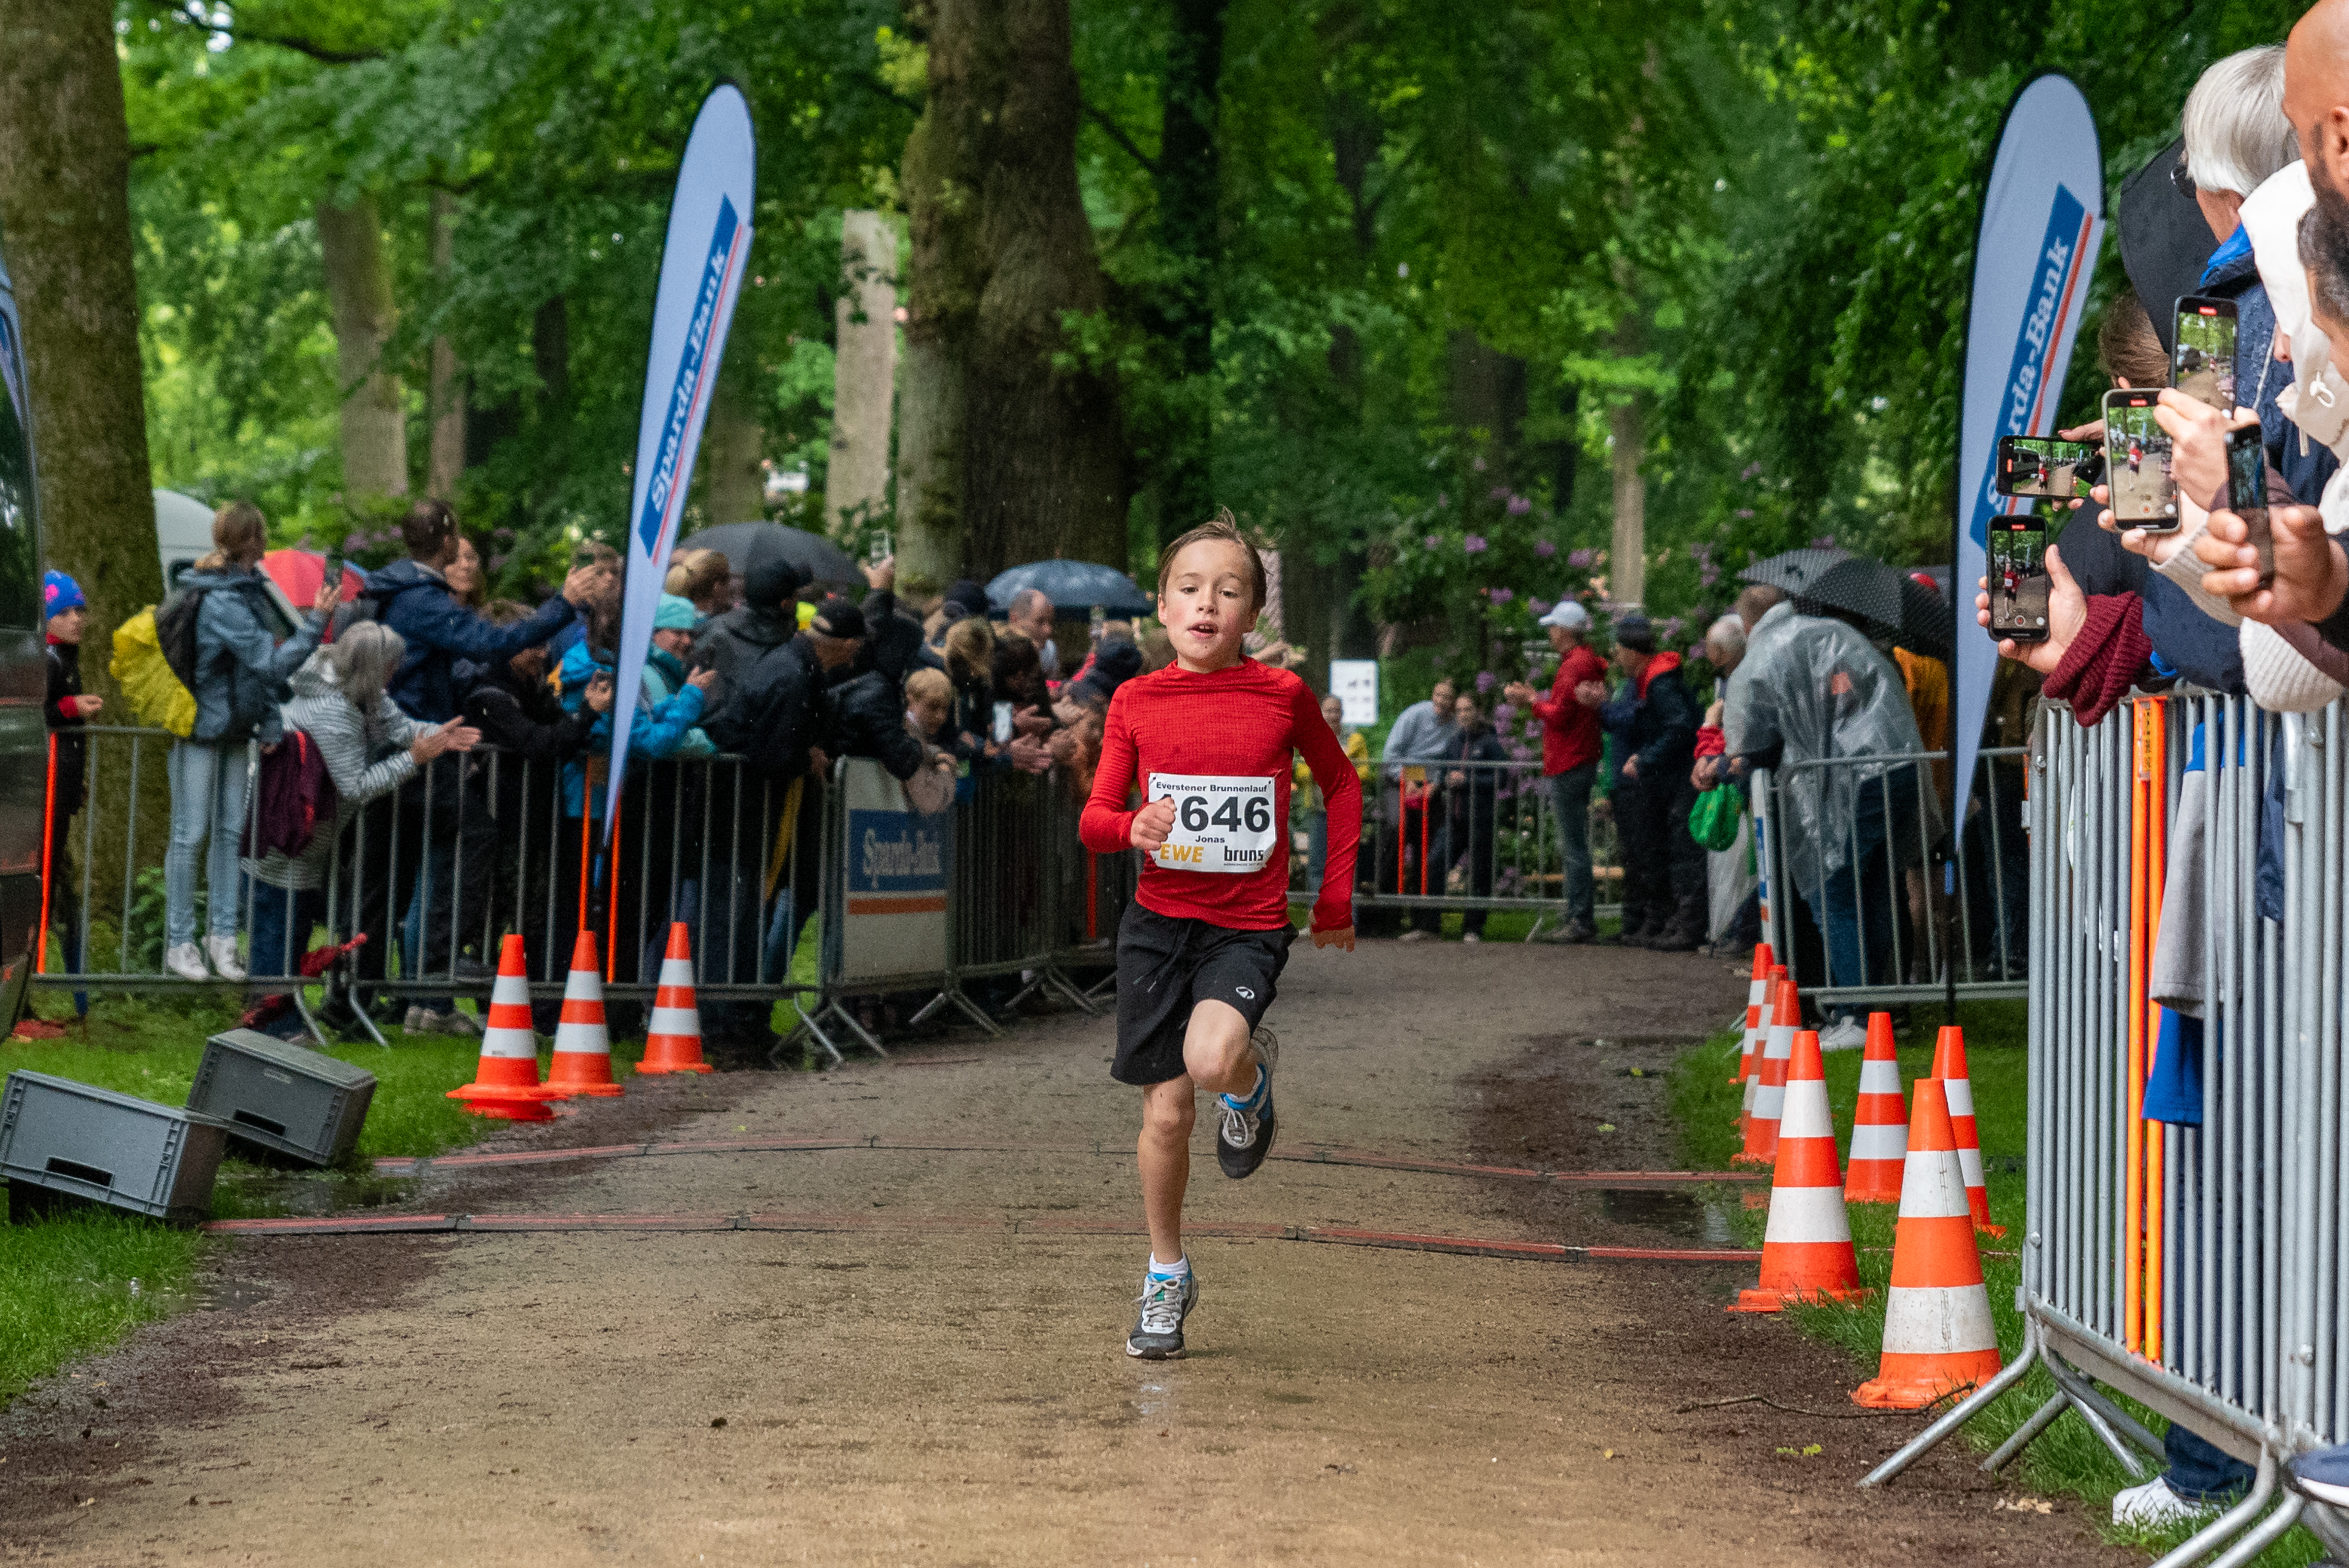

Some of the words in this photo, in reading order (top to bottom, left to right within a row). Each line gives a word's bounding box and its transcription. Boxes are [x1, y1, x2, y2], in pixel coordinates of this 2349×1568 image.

[651, 243, 726, 513] Sparda-Bank
[1987, 236, 2069, 513] Srda-Bank
[1156, 782, 1207, 792] Everstener
[1210, 784, 1267, 792] Brunnenlauf
[1161, 794, 1270, 833] 646
[1160, 844, 1204, 863] EWE
[1224, 846, 1264, 861] bruns
[1195, 835, 1226, 844] Jonas
